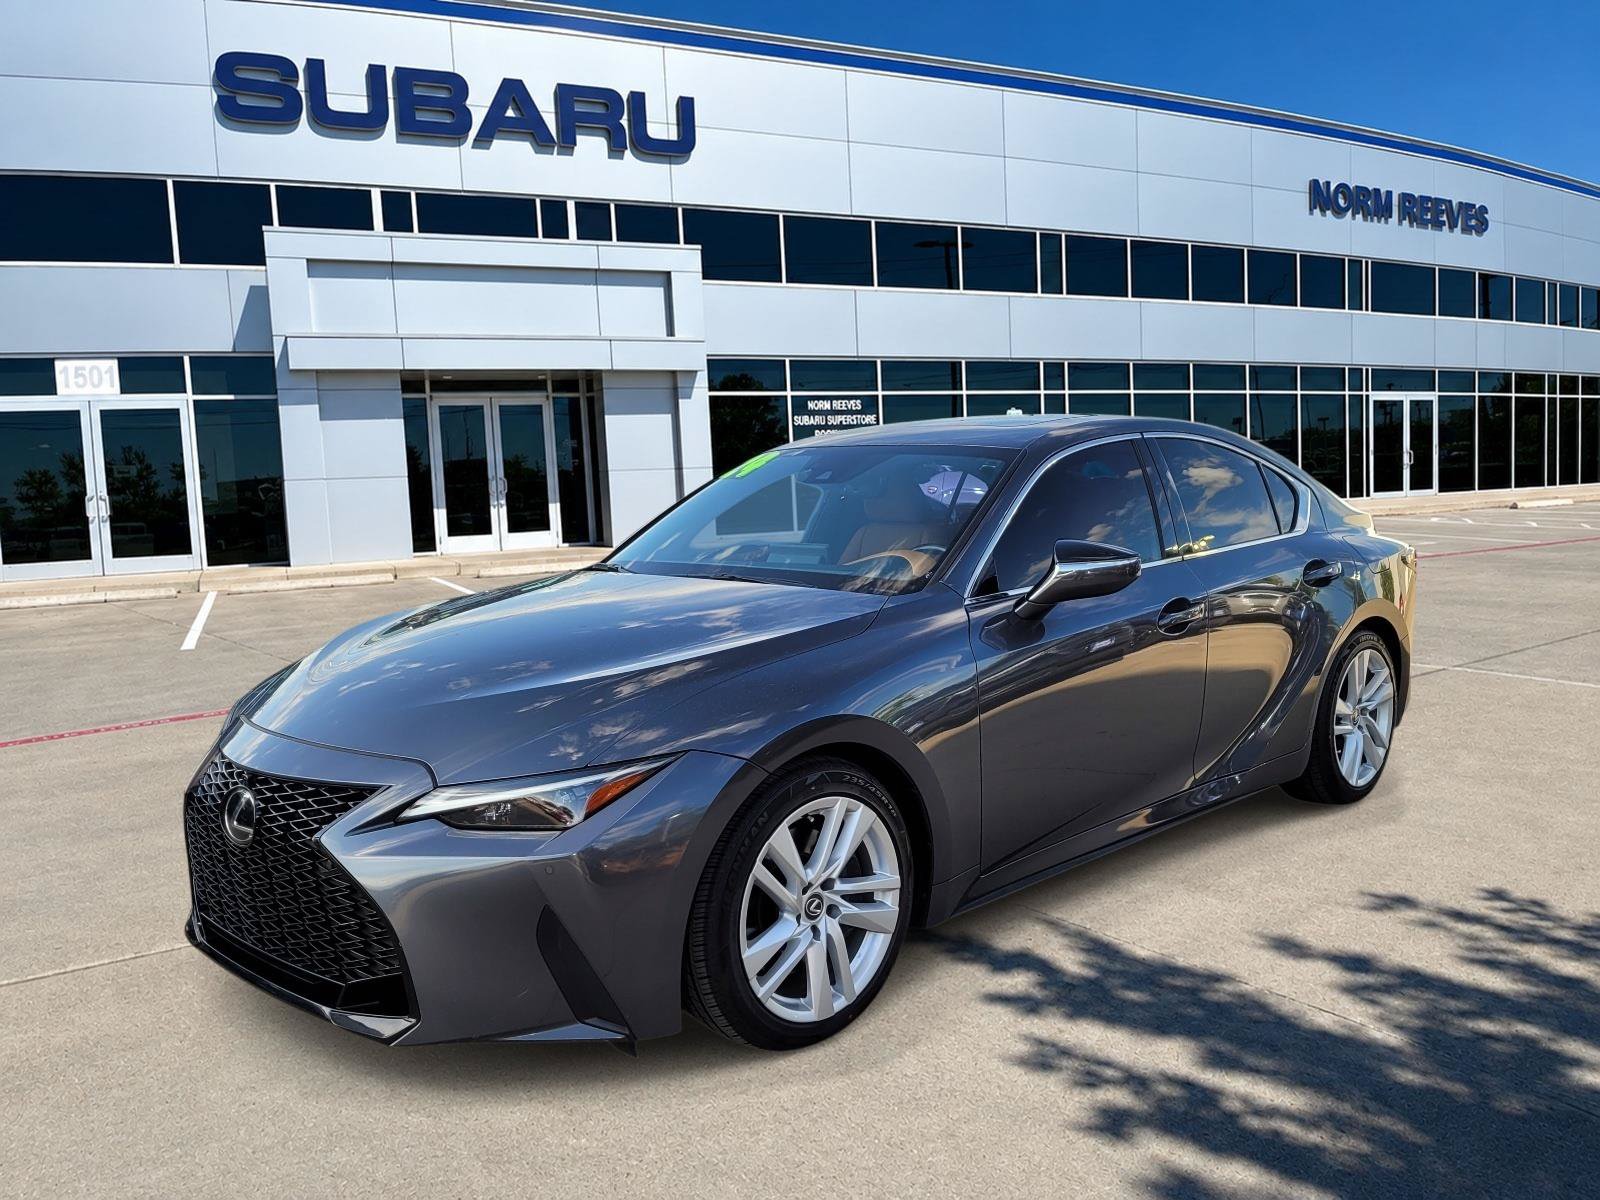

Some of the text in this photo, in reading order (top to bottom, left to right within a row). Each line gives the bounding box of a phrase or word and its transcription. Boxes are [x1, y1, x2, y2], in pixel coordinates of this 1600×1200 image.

[214, 51, 696, 156] SUBARU
[1309, 179, 1490, 234] NORM REEVES
[59, 365, 115, 388] 1501
[807, 399, 862, 411] NORM REEVES
[793, 414, 877, 426] SUBARU SUPERSTORE
